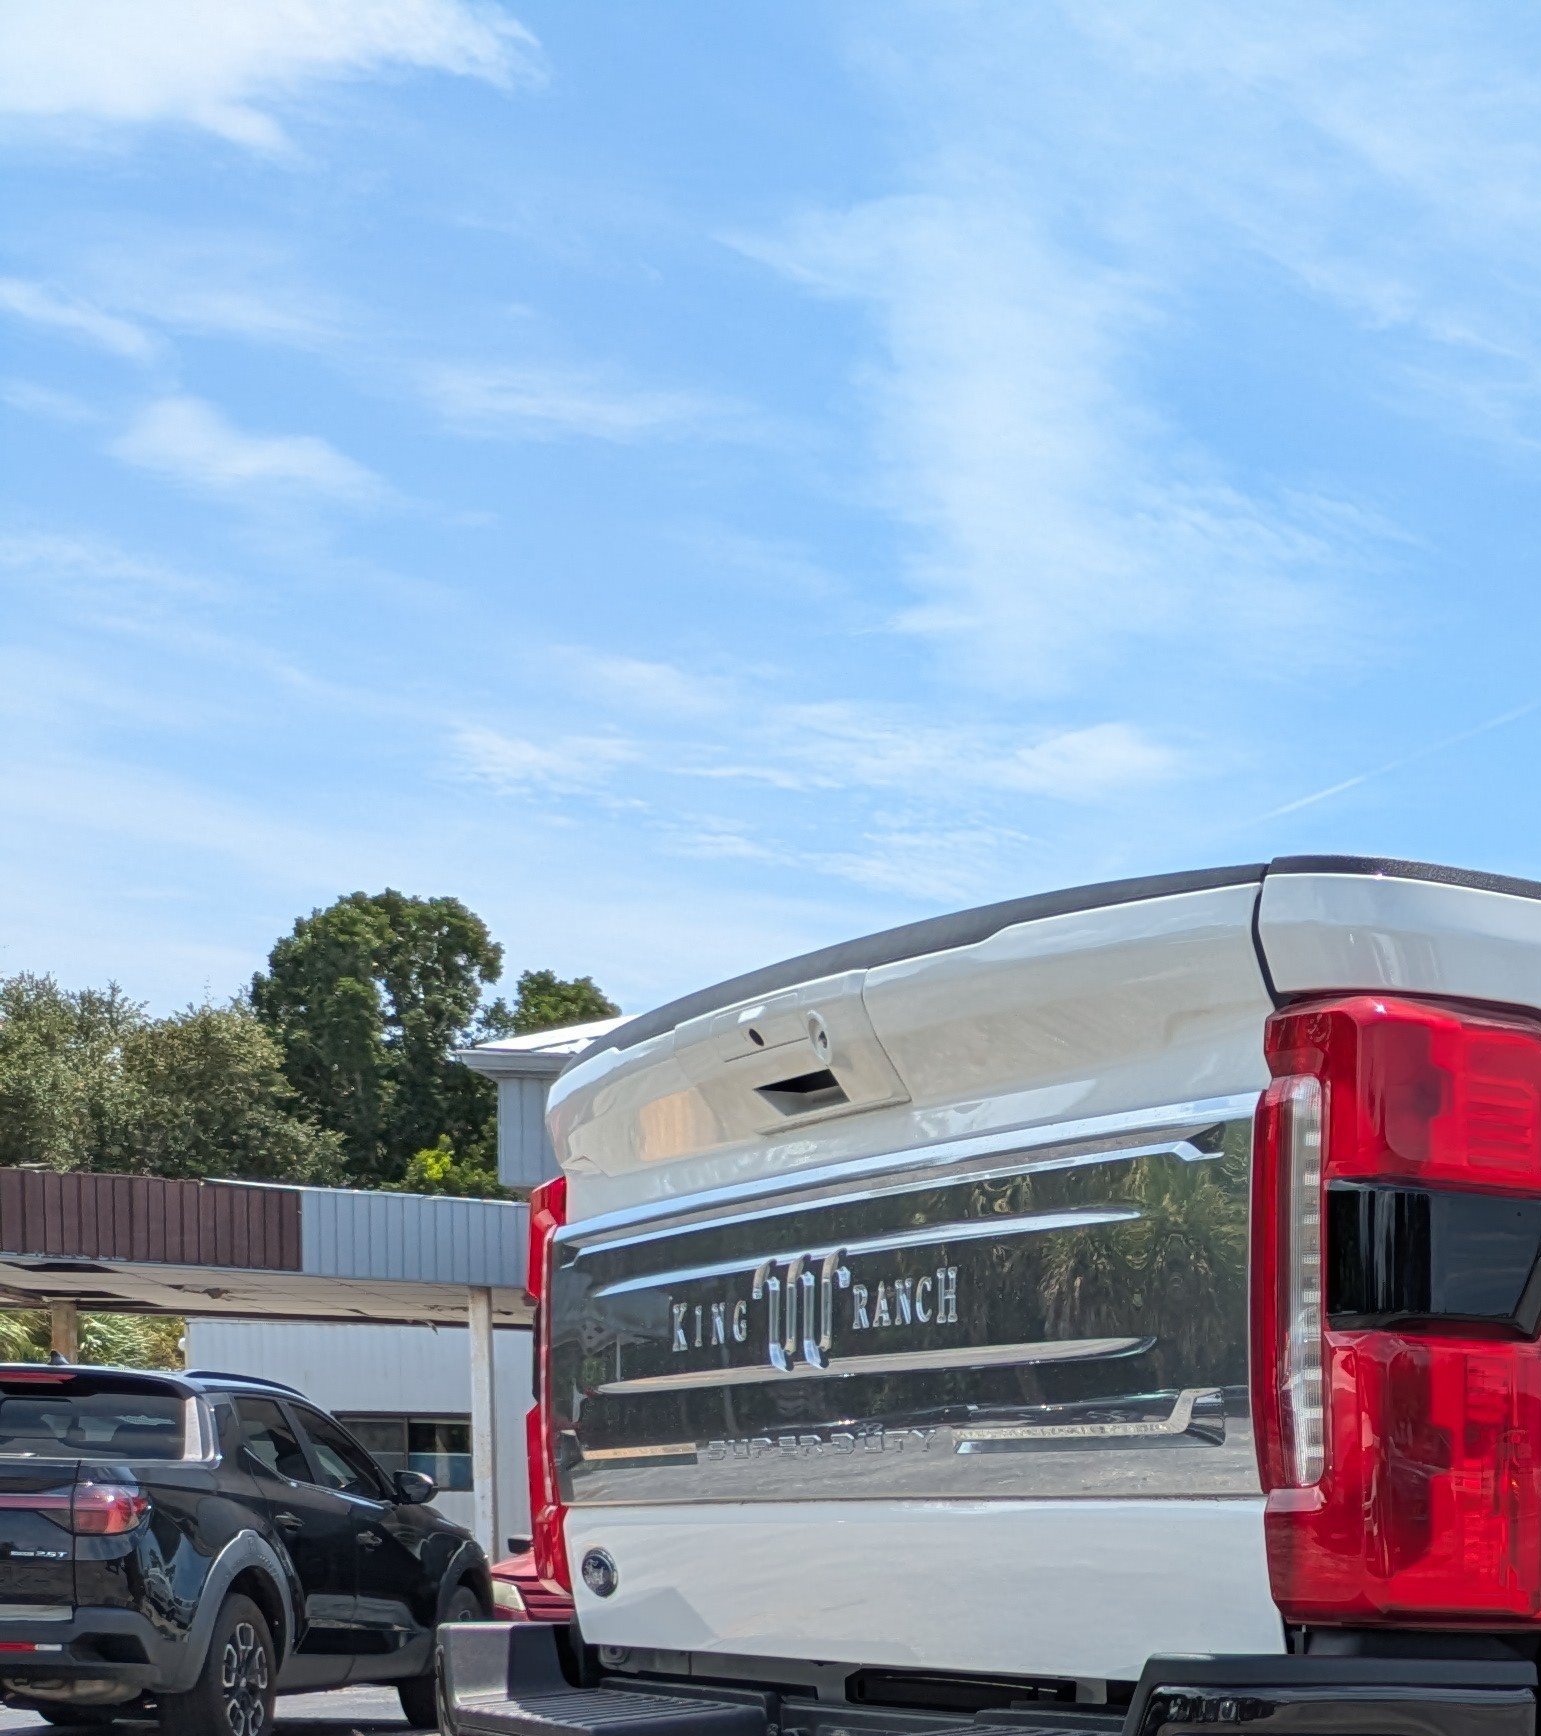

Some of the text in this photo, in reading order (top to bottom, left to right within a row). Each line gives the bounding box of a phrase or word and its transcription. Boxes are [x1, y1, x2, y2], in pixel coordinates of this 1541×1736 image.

[672, 1266, 958, 1352] KING RANCH
[707, 1429, 936, 1460] SUPER DUTY
